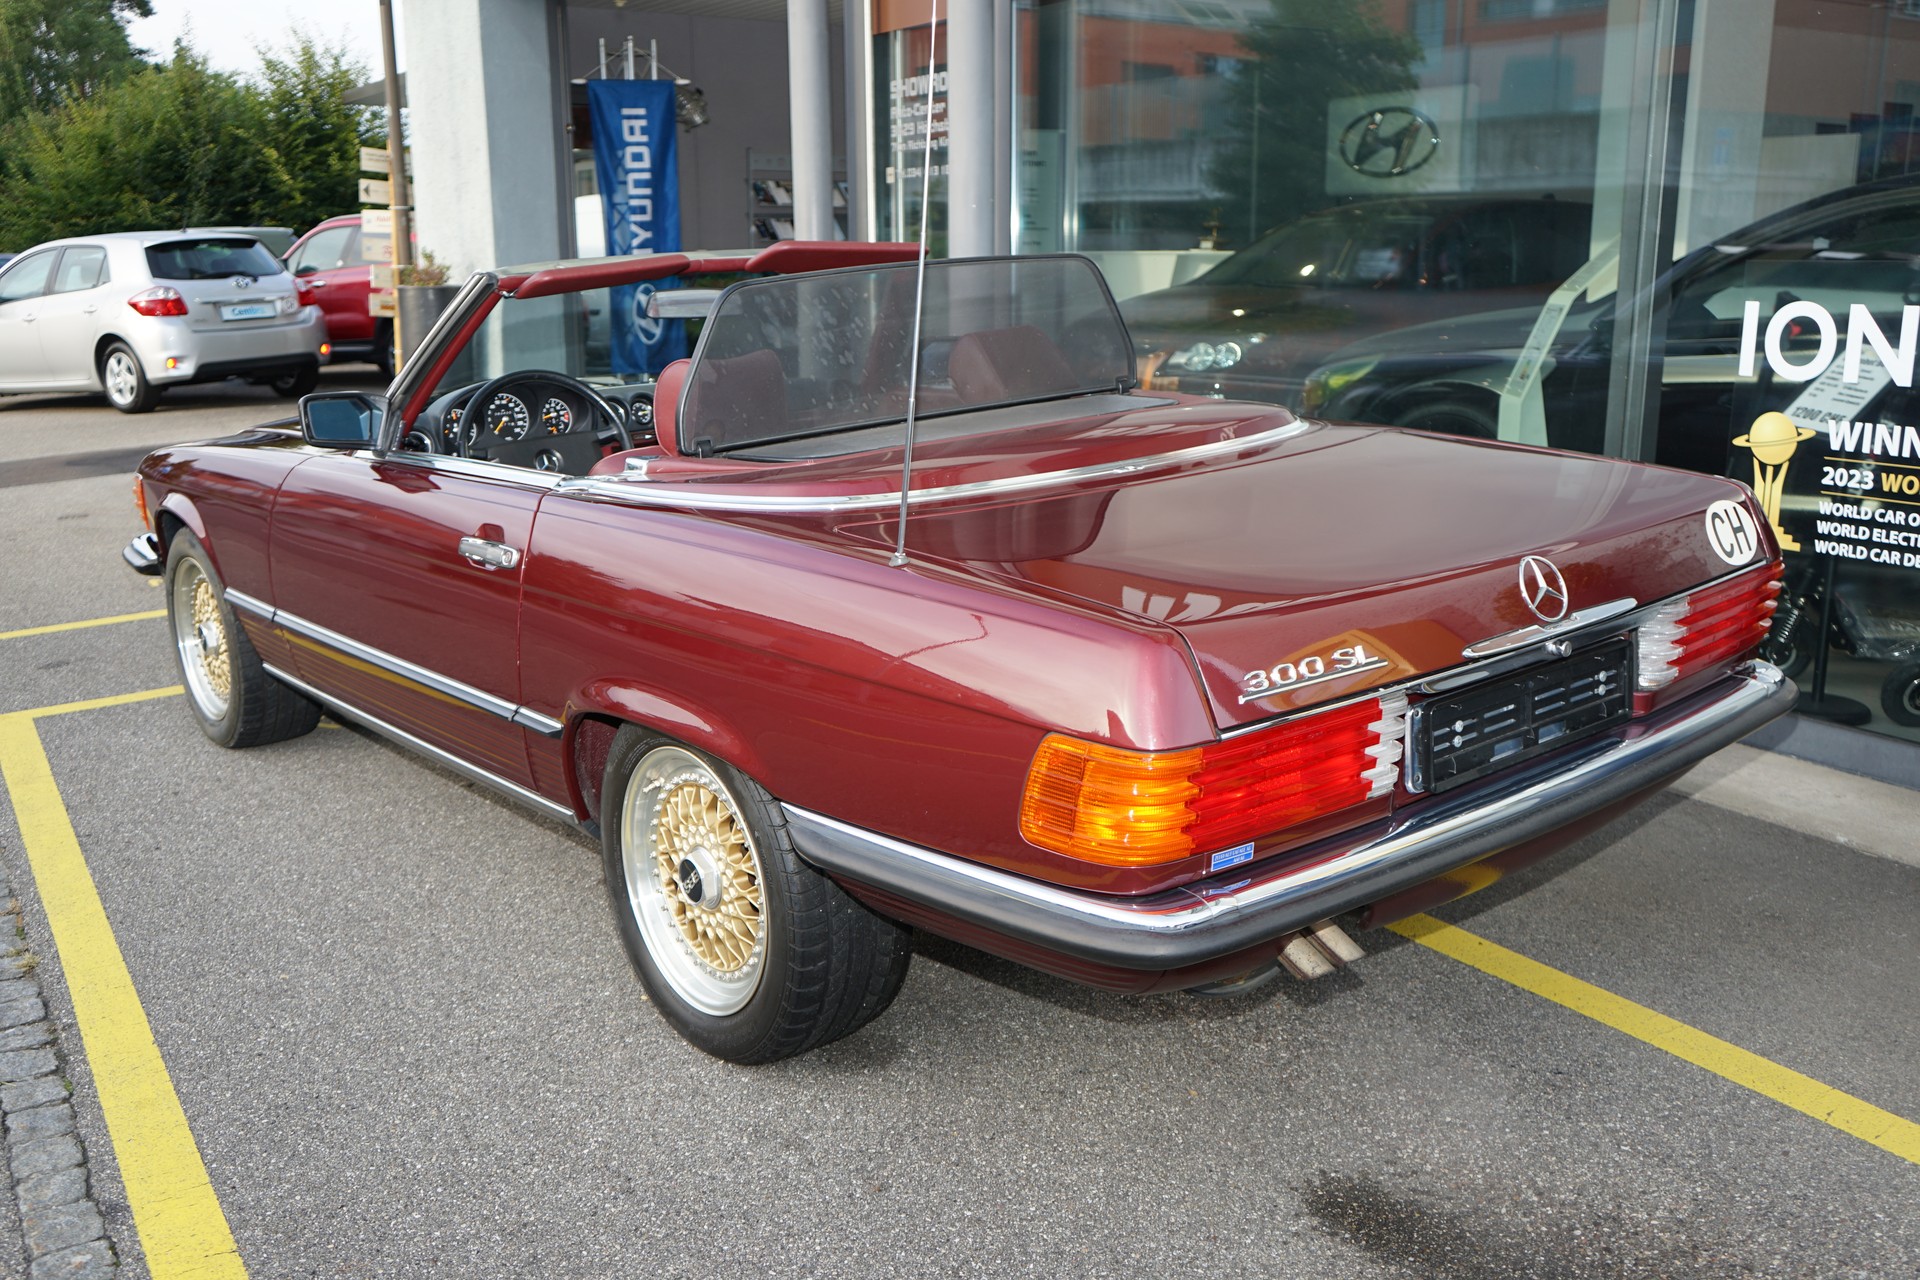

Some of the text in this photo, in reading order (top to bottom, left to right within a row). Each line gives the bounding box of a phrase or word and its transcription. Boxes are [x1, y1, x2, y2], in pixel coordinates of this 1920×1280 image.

[620, 107, 653, 255] YUNDAI
[1738, 300, 1920, 388] ION
[1821, 466, 1874, 490] 2023
[1817, 520, 1870, 540] WORLD
[1819, 501, 1872, 520] WORLD
[1875, 509, 1906, 525] CAR
[1711, 506, 1752, 558] CH
[1814, 539, 1867, 560] WORLD
[1870, 549, 1901, 565] CAR
[1243, 645, 1379, 692] 300 SL
